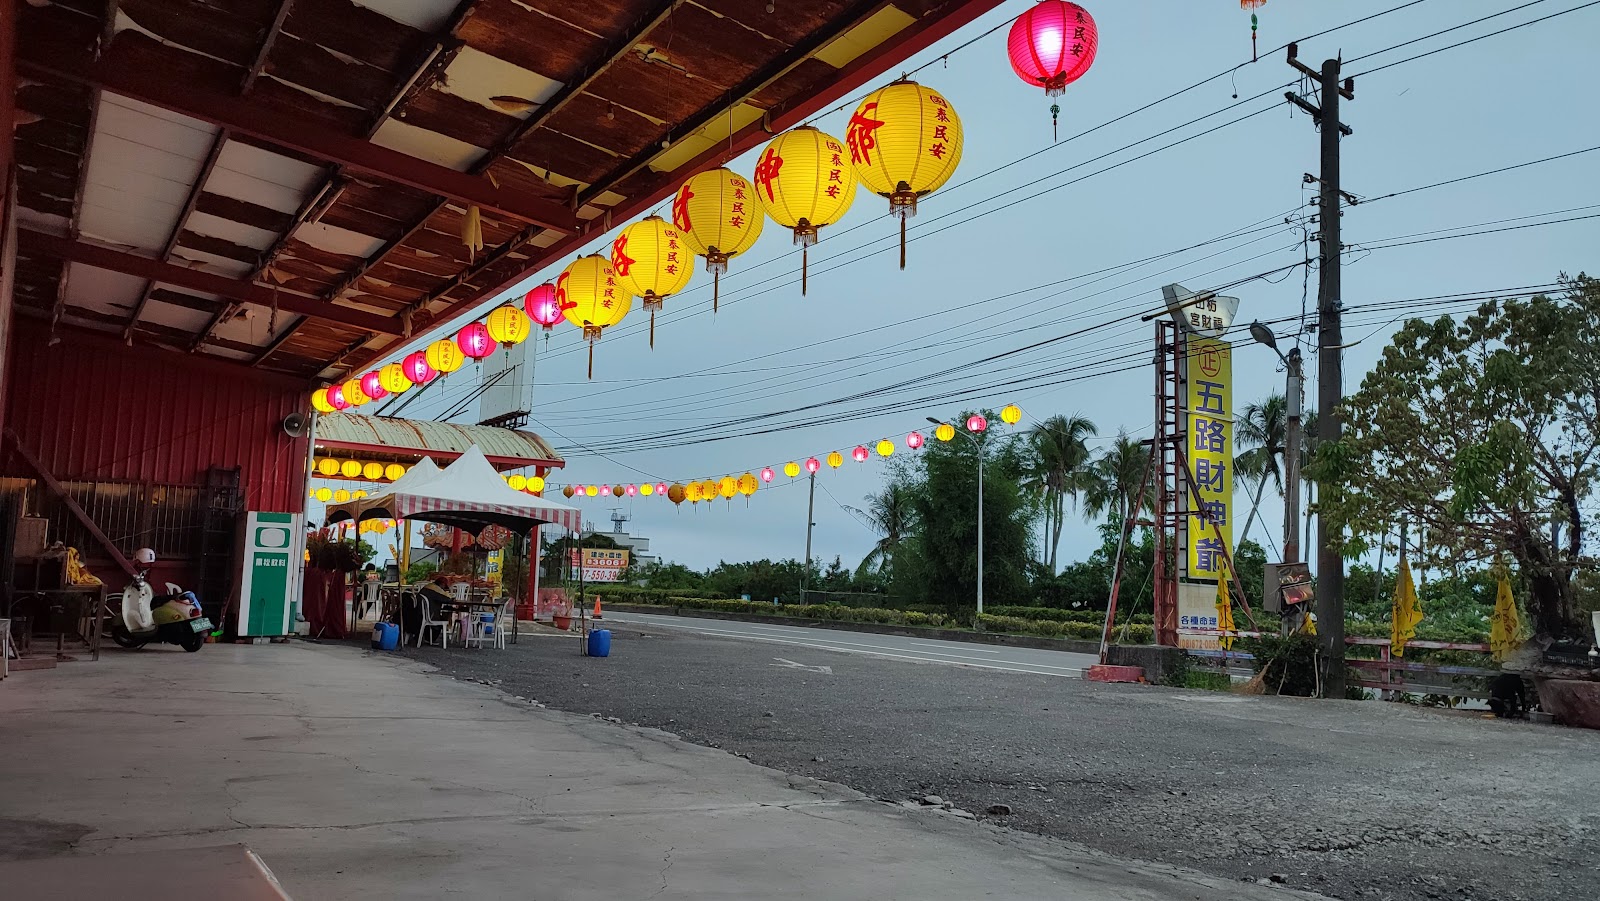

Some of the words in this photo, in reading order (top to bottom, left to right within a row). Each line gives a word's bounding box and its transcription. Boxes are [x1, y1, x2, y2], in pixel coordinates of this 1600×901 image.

[929, 95, 950, 160] 國泰民安
[825, 139, 844, 199] 國泰民安
[729, 178, 746, 229] 國泰民安
[664, 229, 680, 276] 國泰民安
[1194, 380, 1227, 572] 五路財神爺
[1181, 615, 1217, 626] 各種命理
